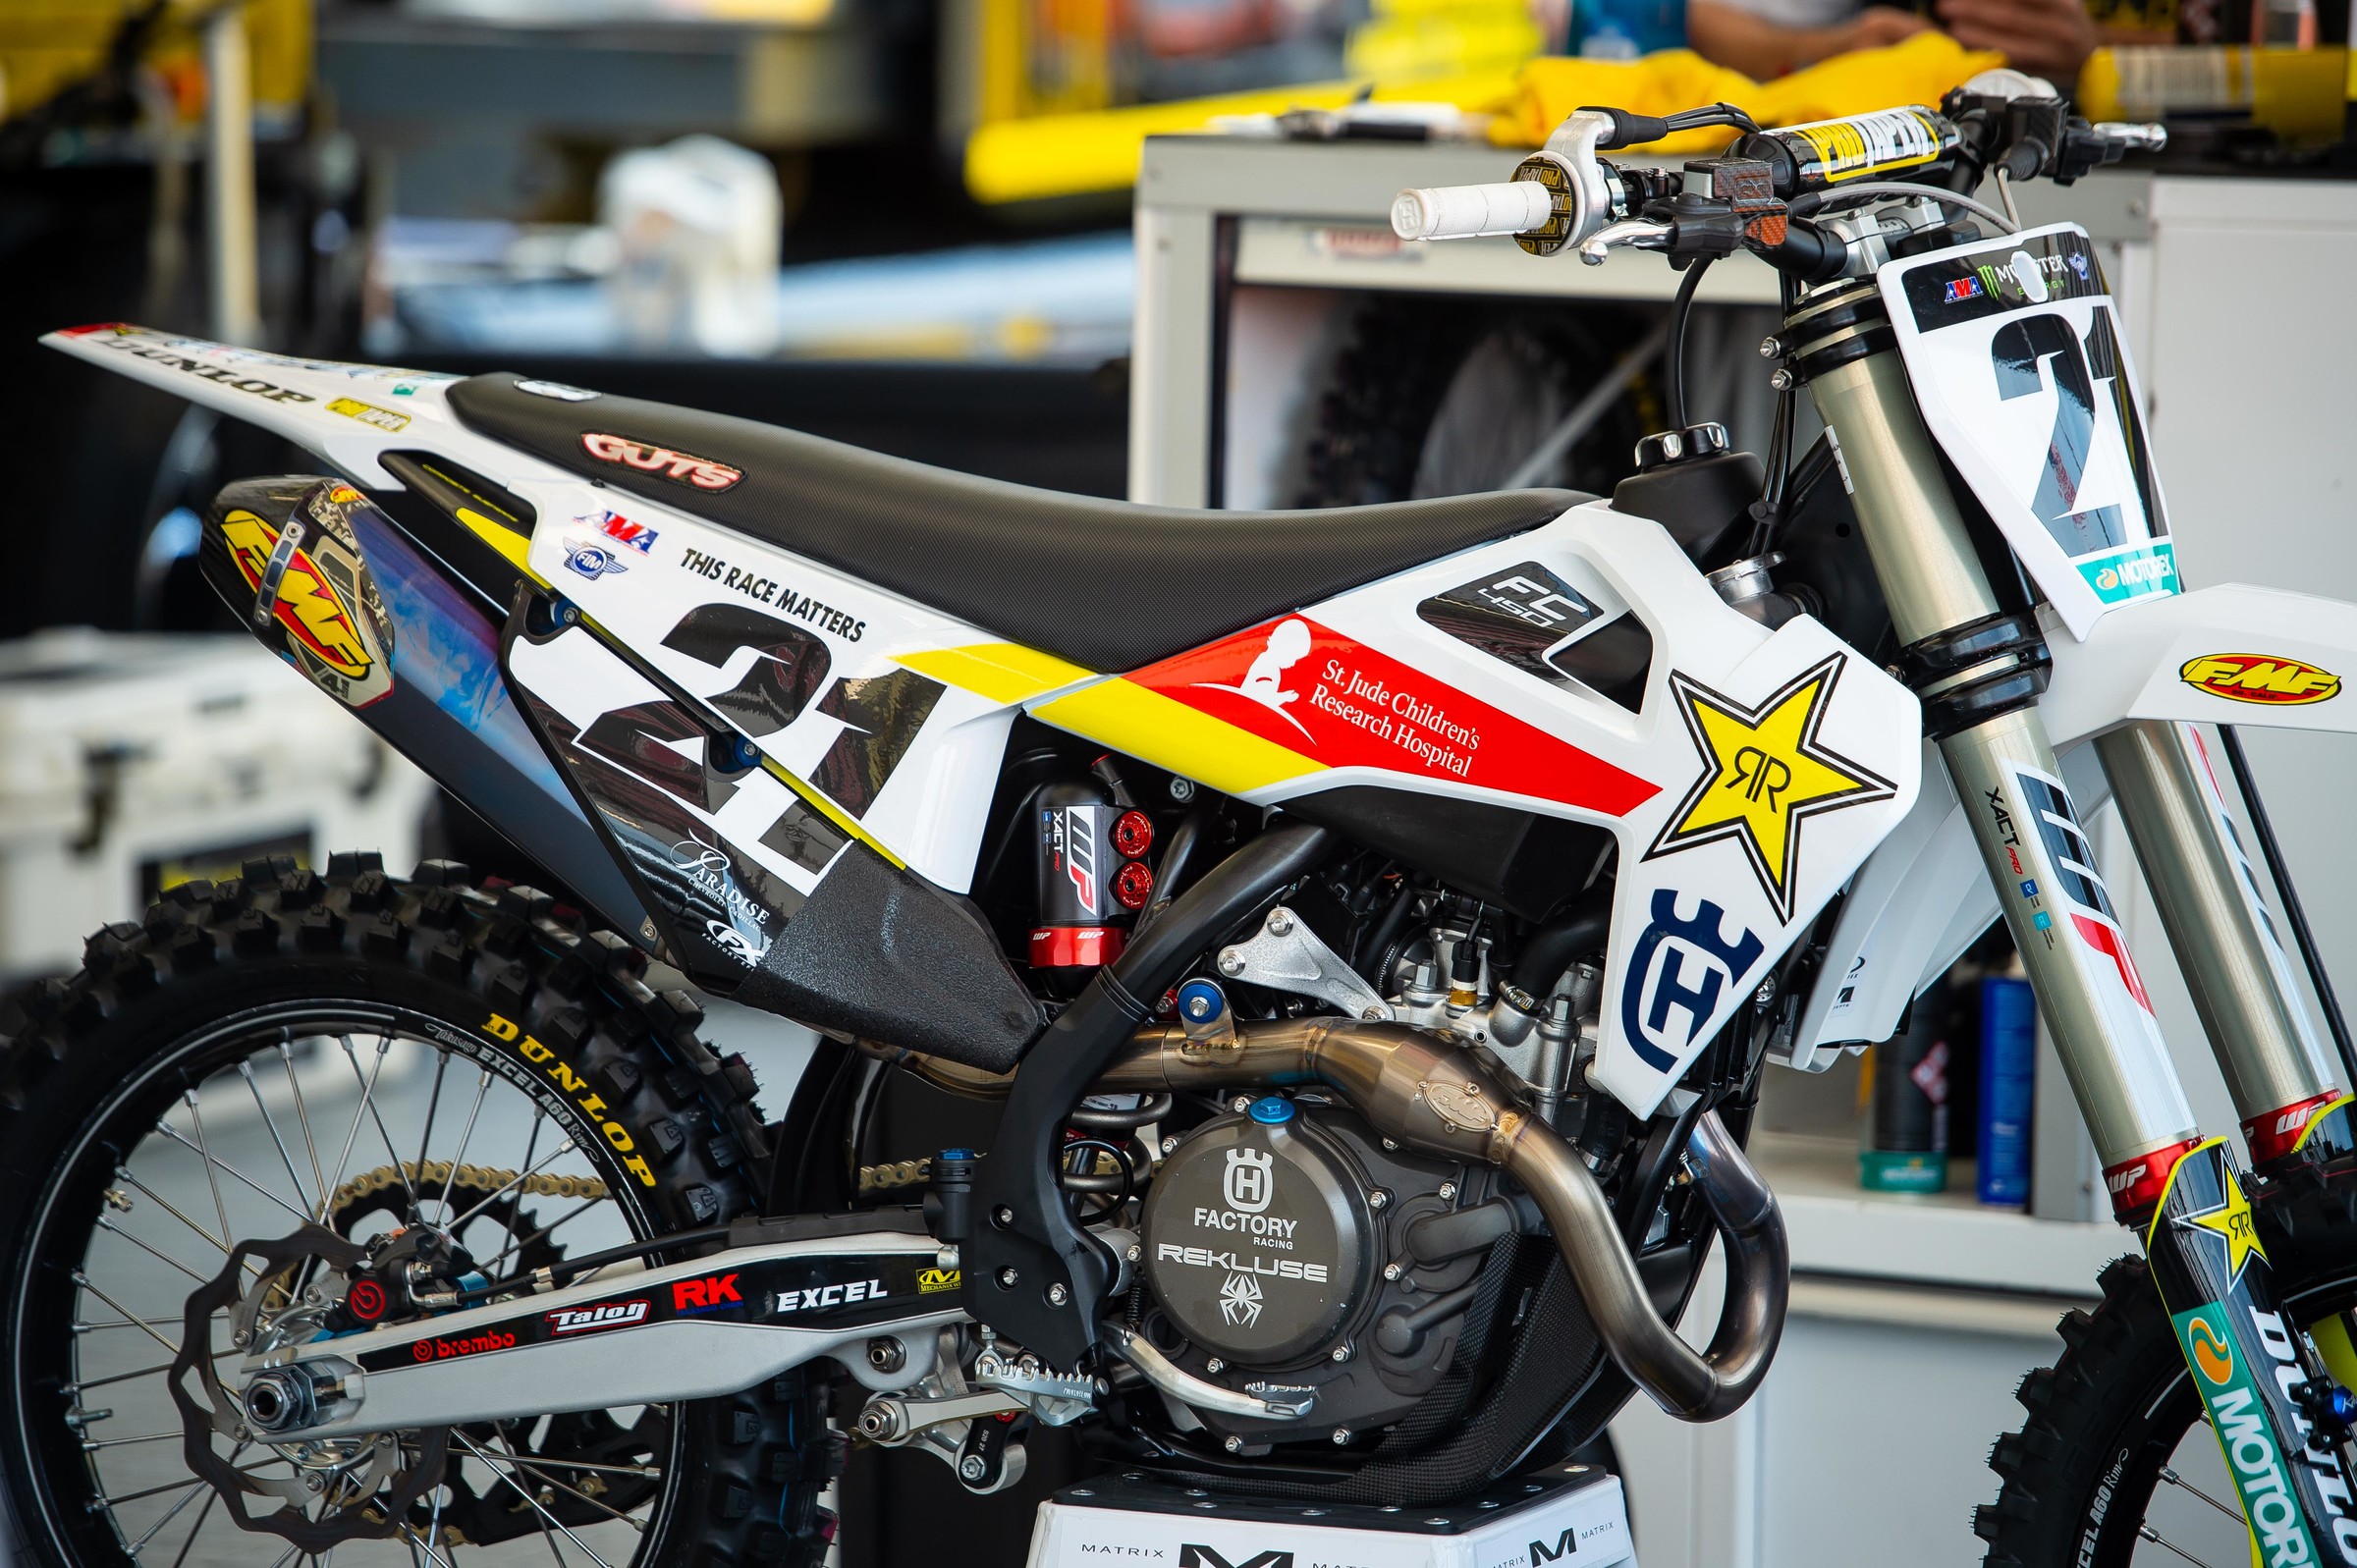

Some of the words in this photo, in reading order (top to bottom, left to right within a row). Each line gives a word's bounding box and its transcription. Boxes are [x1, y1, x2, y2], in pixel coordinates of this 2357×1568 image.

[1945, 276, 1984, 302] AMA
[91, 337, 316, 404] DUNLOP
[1991, 305, 2169, 558] 21
[582, 433, 743, 488] GUTS
[573, 509, 659, 555] AMA
[576, 551, 603, 569] FIM
[2117, 554, 2174, 587] MOTOREX
[221, 518, 375, 666] FMF
[681, 548, 723, 581] THIS
[724, 567, 778, 604] RACE
[775, 588, 866, 643] MATTERS
[1477, 588, 1555, 627] 450
[1493, 575, 1588, 622] FC
[2182, 659, 2340, 694] FMF
[1322, 659, 1346, 687] St.
[1343, 670, 1391, 707] Jude
[1391, 691, 1481, 751] Children's
[571, 603, 949, 877] 21
[1309, 683, 1393, 740] Research
[1393, 723, 1473, 778] Hospital
[1053, 811, 1064, 854] XACT
[1984, 785, 2021, 846] XACT
[669, 828, 770, 925] PARADISE
[2005, 845, 2023, 876] PRO
[687, 878, 726, 907] CHEVROLET
[701, 932, 739, 961] FACTORY
[425, 1022, 478, 1054] Takasago
[476, 1047, 539, 1097] EXCEL
[539, 1093, 574, 1126] A60
[568, 1123, 600, 1162] Rim
[481, 1012, 656, 1187] DUNLOP
[2109, 1163, 2147, 1193] WP
[1194, 1208, 1297, 1238] FACTORY
[1253, 1236, 1293, 1250] RACING
[1158, 1243, 1328, 1283] REKLUSE
[672, 1273, 743, 1310] RK
[777, 1279, 888, 1313] EXCEL
[550, 1302, 648, 1332] Talon
[436, 1331, 516, 1357] brembo
[2089, 1485, 2112, 1526] A60
[2103, 1447, 2129, 1489] Rim
[2211, 1386, 2316, 1568] MOTOR
[1081, 1543, 1164, 1559] MATRIX
[1581, 1522, 1614, 1540] MATRIX
